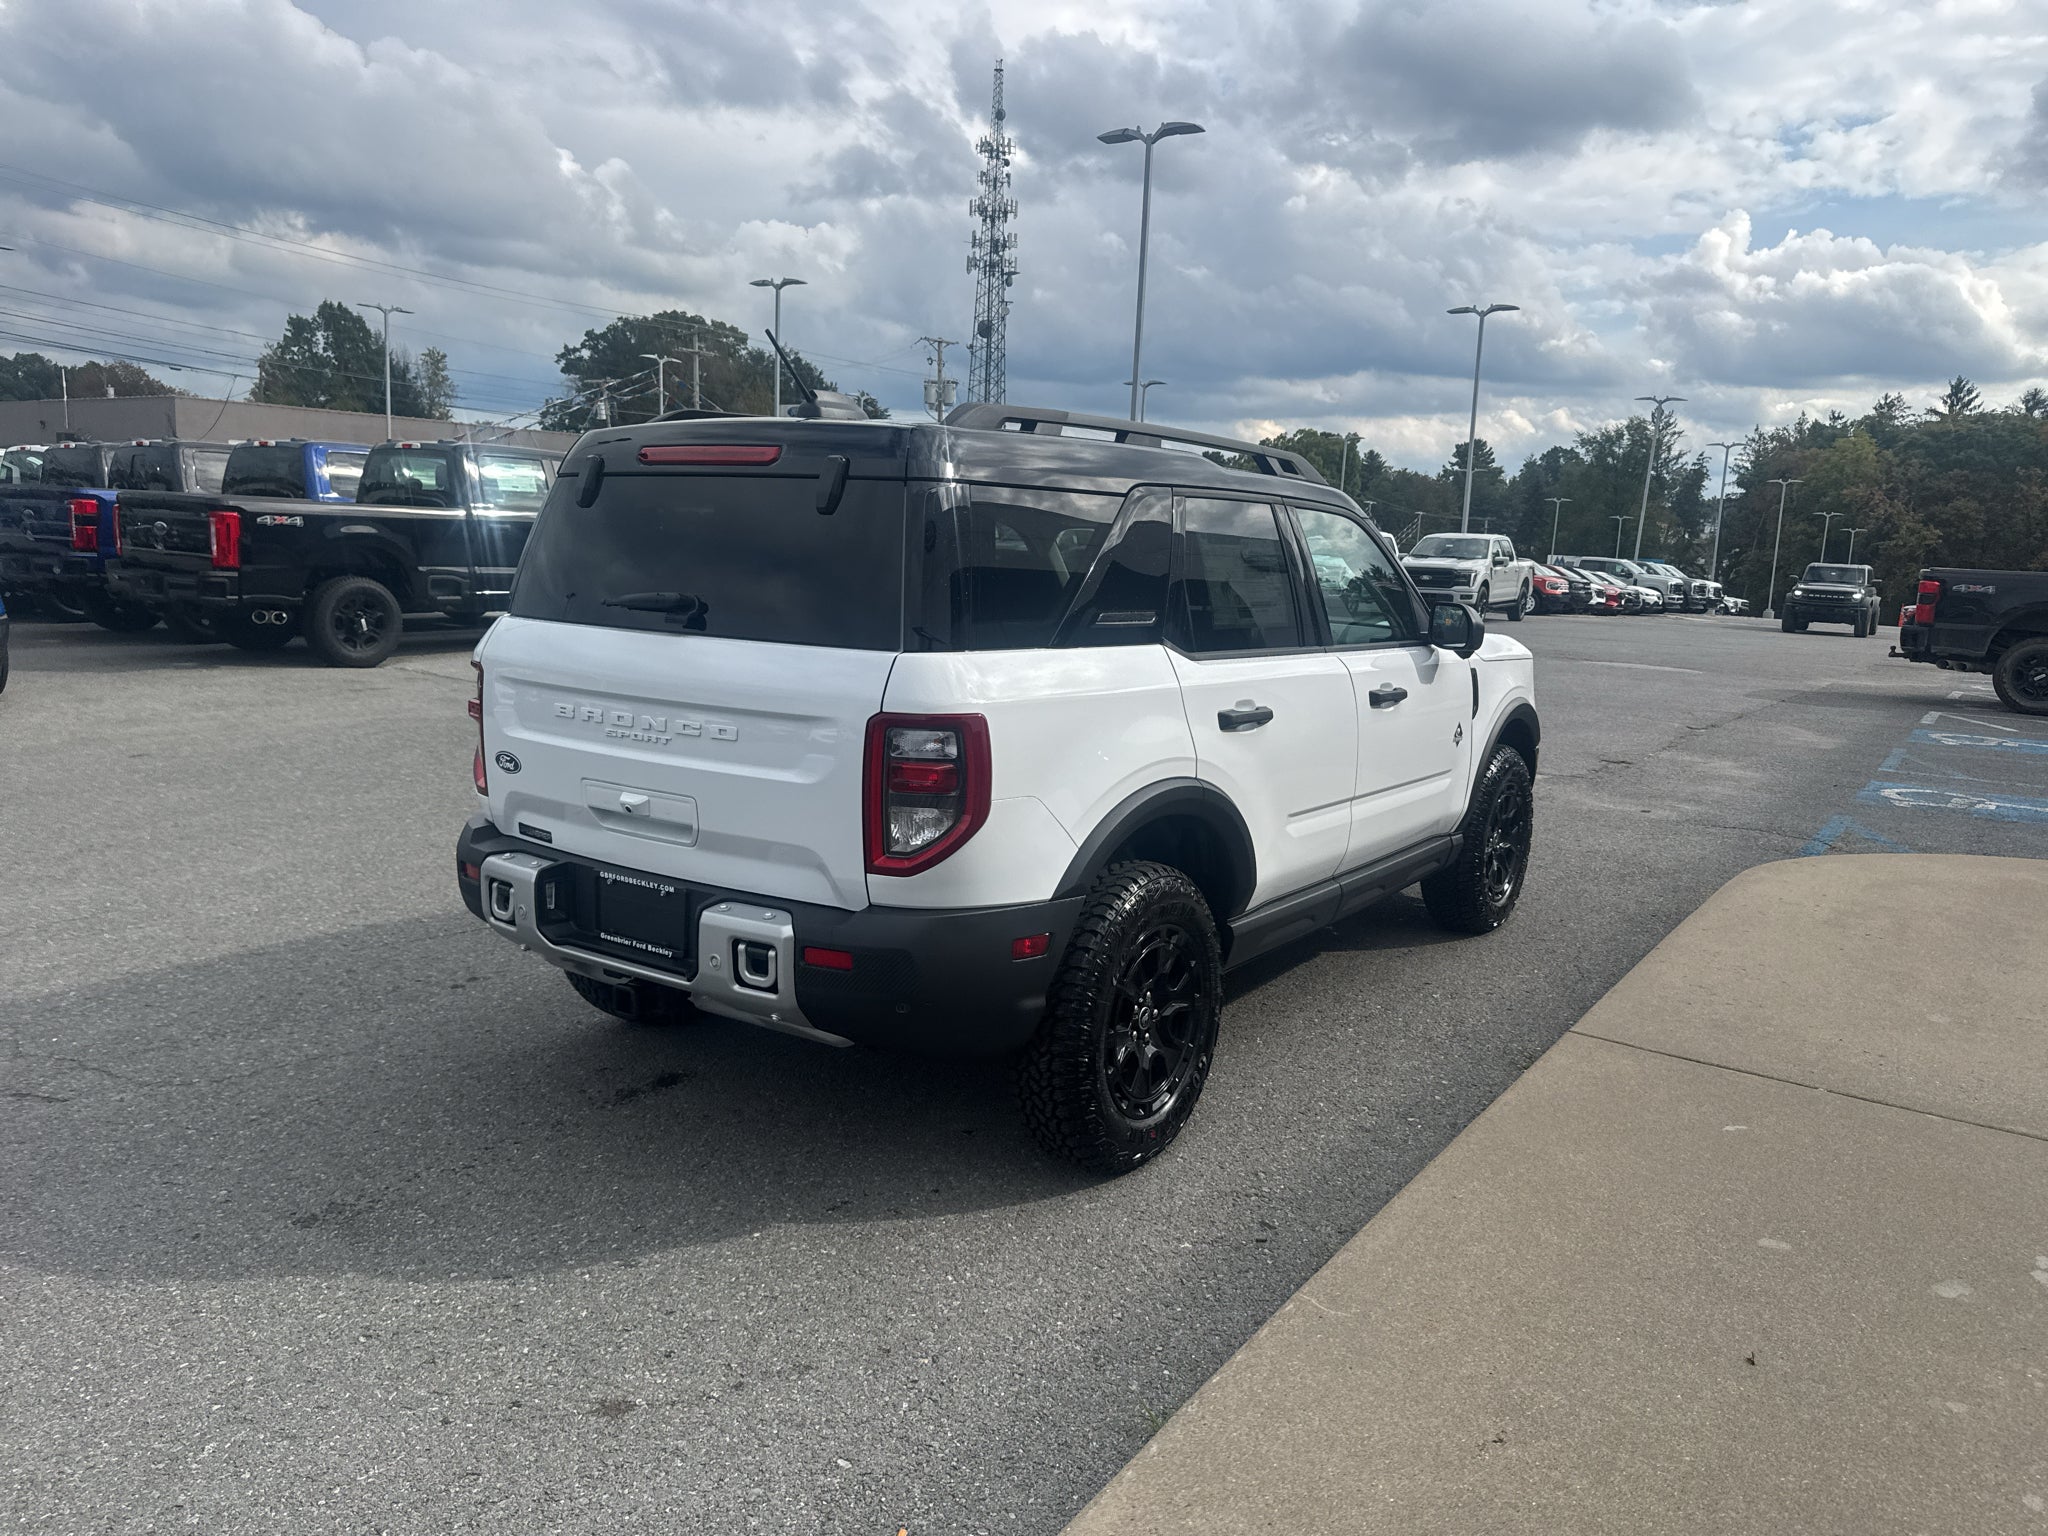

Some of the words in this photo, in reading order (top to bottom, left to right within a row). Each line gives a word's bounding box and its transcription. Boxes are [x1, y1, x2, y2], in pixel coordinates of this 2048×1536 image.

[553, 702, 739, 741] BRONCO
[605, 728, 673, 745] SPORT
[600, 871, 675, 893] GBRFORDBECKLEY.COM
[600, 932, 632, 946] Greenbrier
[632, 940, 647, 950] Ford
[647, 944, 673, 959] Beckley
